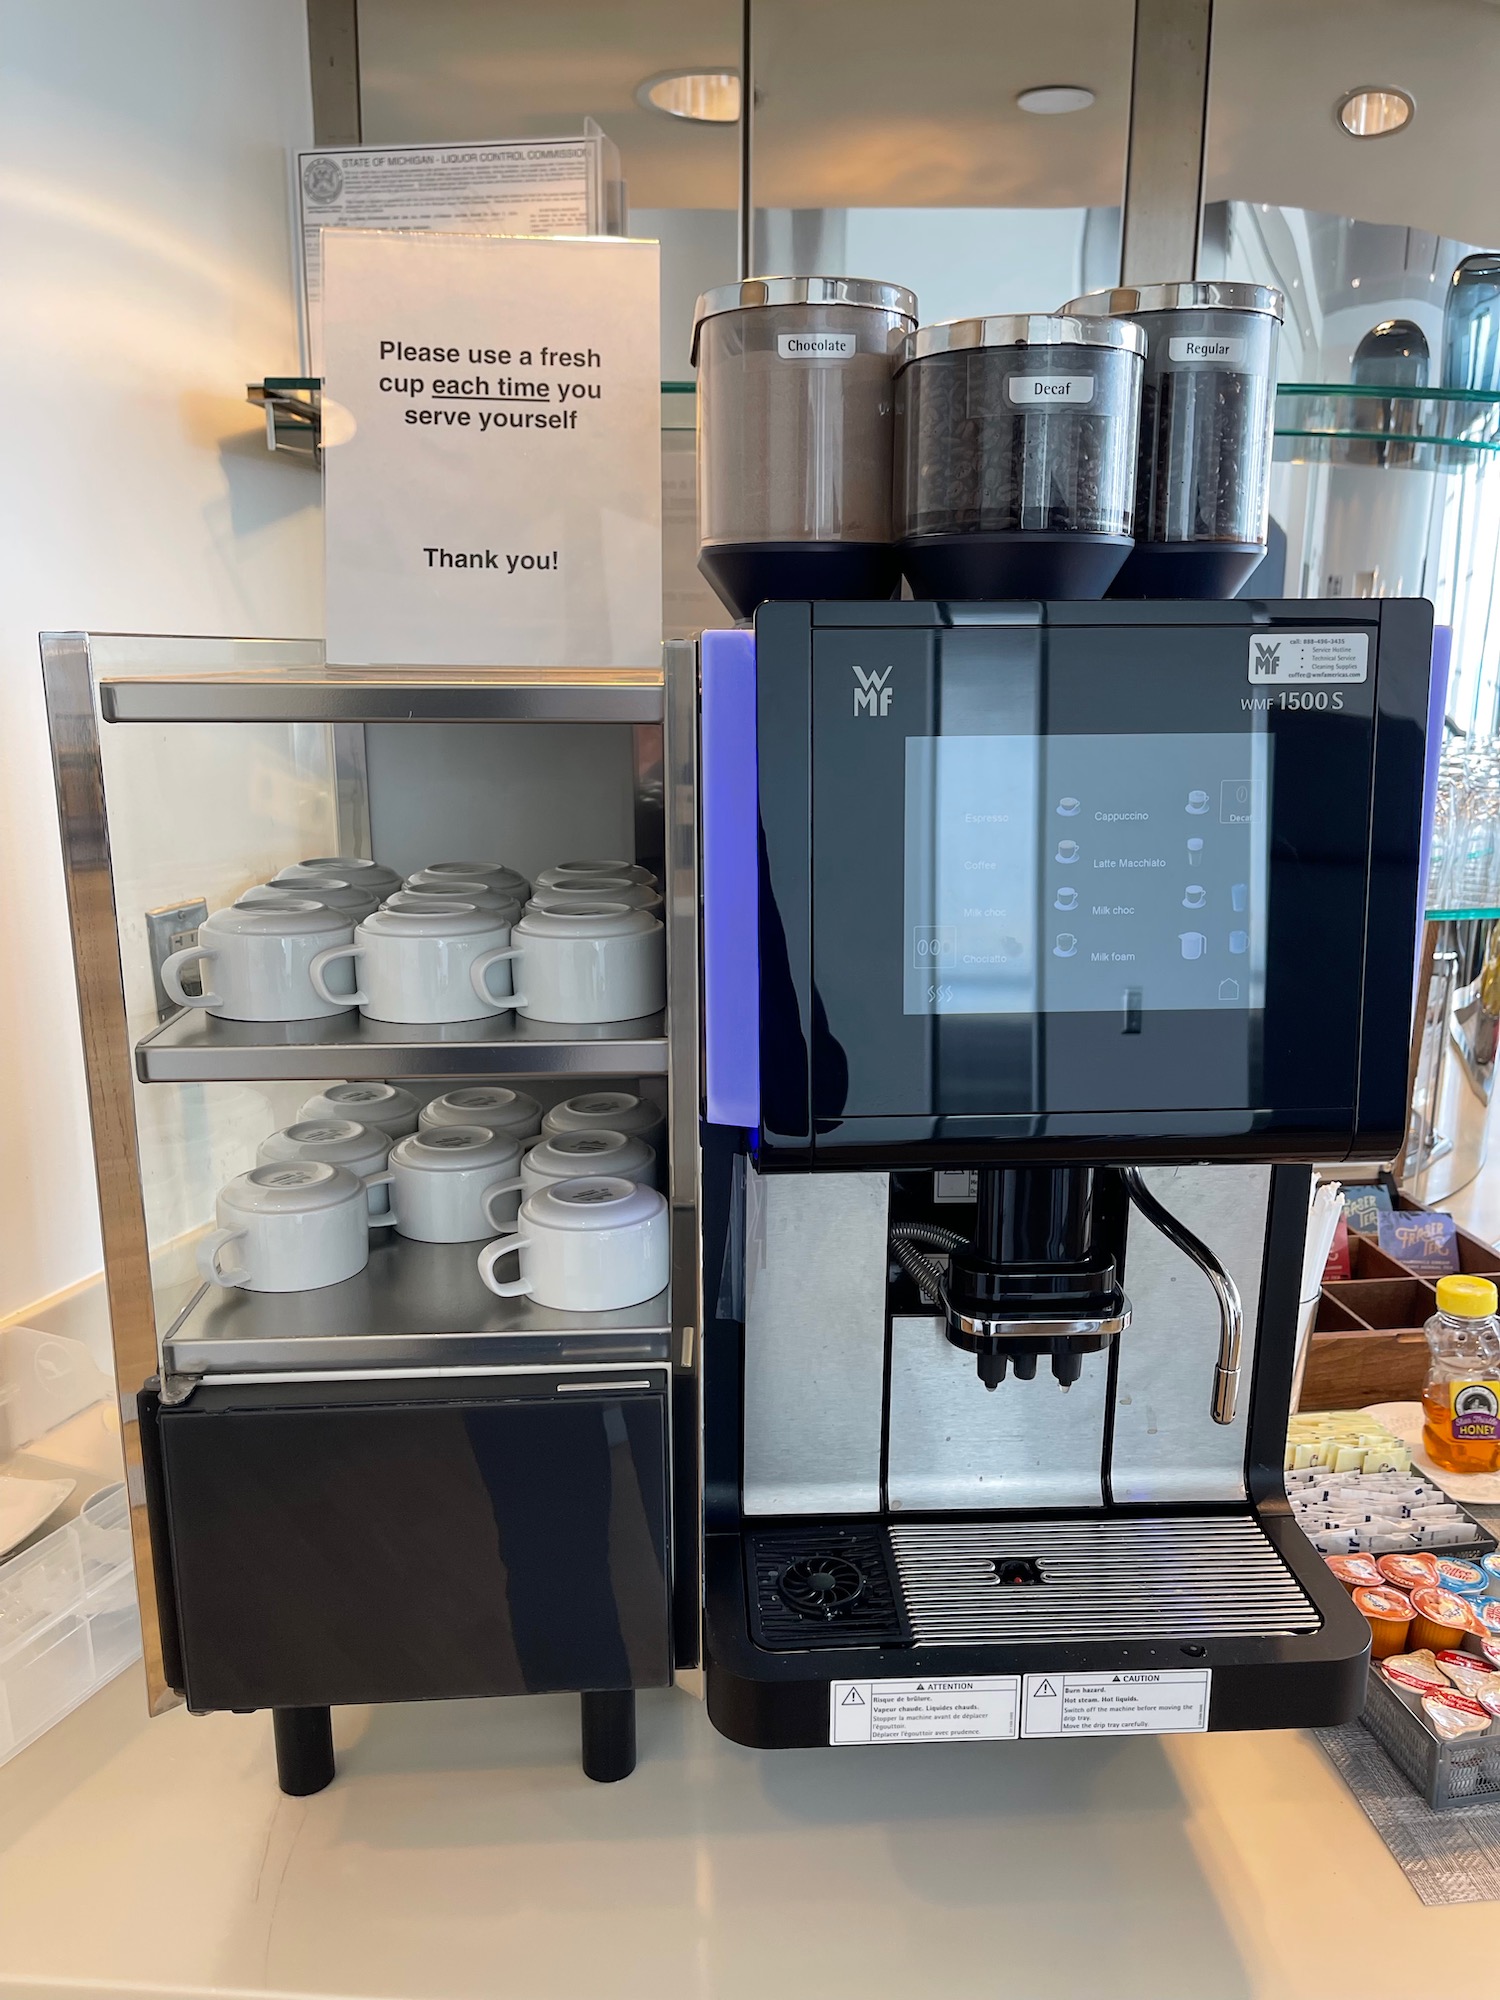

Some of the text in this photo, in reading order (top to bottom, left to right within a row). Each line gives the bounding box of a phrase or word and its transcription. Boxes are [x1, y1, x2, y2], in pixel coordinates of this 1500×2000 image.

[342, 158, 371, 169] STATE
[374, 157, 386, 168] OF
[388, 155, 435, 167] MICHIGAN
[441, 153, 478, 165] LIQUOR
[480, 151, 526, 163] CONTROL
[787, 340, 847, 354] Chocolate
[1186, 342, 1230, 357] Regular
[380, 341, 602, 368] Please use a fresh
[379, 376, 602, 403] cup each time you
[1034, 382, 1072, 396] Decaf
[404, 409, 578, 432] serve yourself
[423, 548, 558, 574] Thank you!
[1254, 642, 1282, 674] WMF
[852, 666, 893, 716] WMF
[1240, 691, 1344, 710] WMF 1500 S
[965, 813, 1008, 824] Espresso
[1094, 811, 1149, 823] Cappuccino
[964, 860, 996, 870] Coffee
[1094, 858, 1166, 868] Latte Macchiato
[964, 908, 1006, 918] Milk choc
[1092, 906, 1135, 915] Milk choc
[1091, 952, 1136, 962] Milk foam
[1343, 1195, 1376, 1218] RASER
[1395, 1222, 1444, 1250] FRASER
[1423, 1239, 1450, 1256] TEA
[1460, 1425, 1495, 1435] HONEY
[1123, 1674, 1160, 1682] CAUTION
[928, 1682, 974, 1690] ATTENTION
